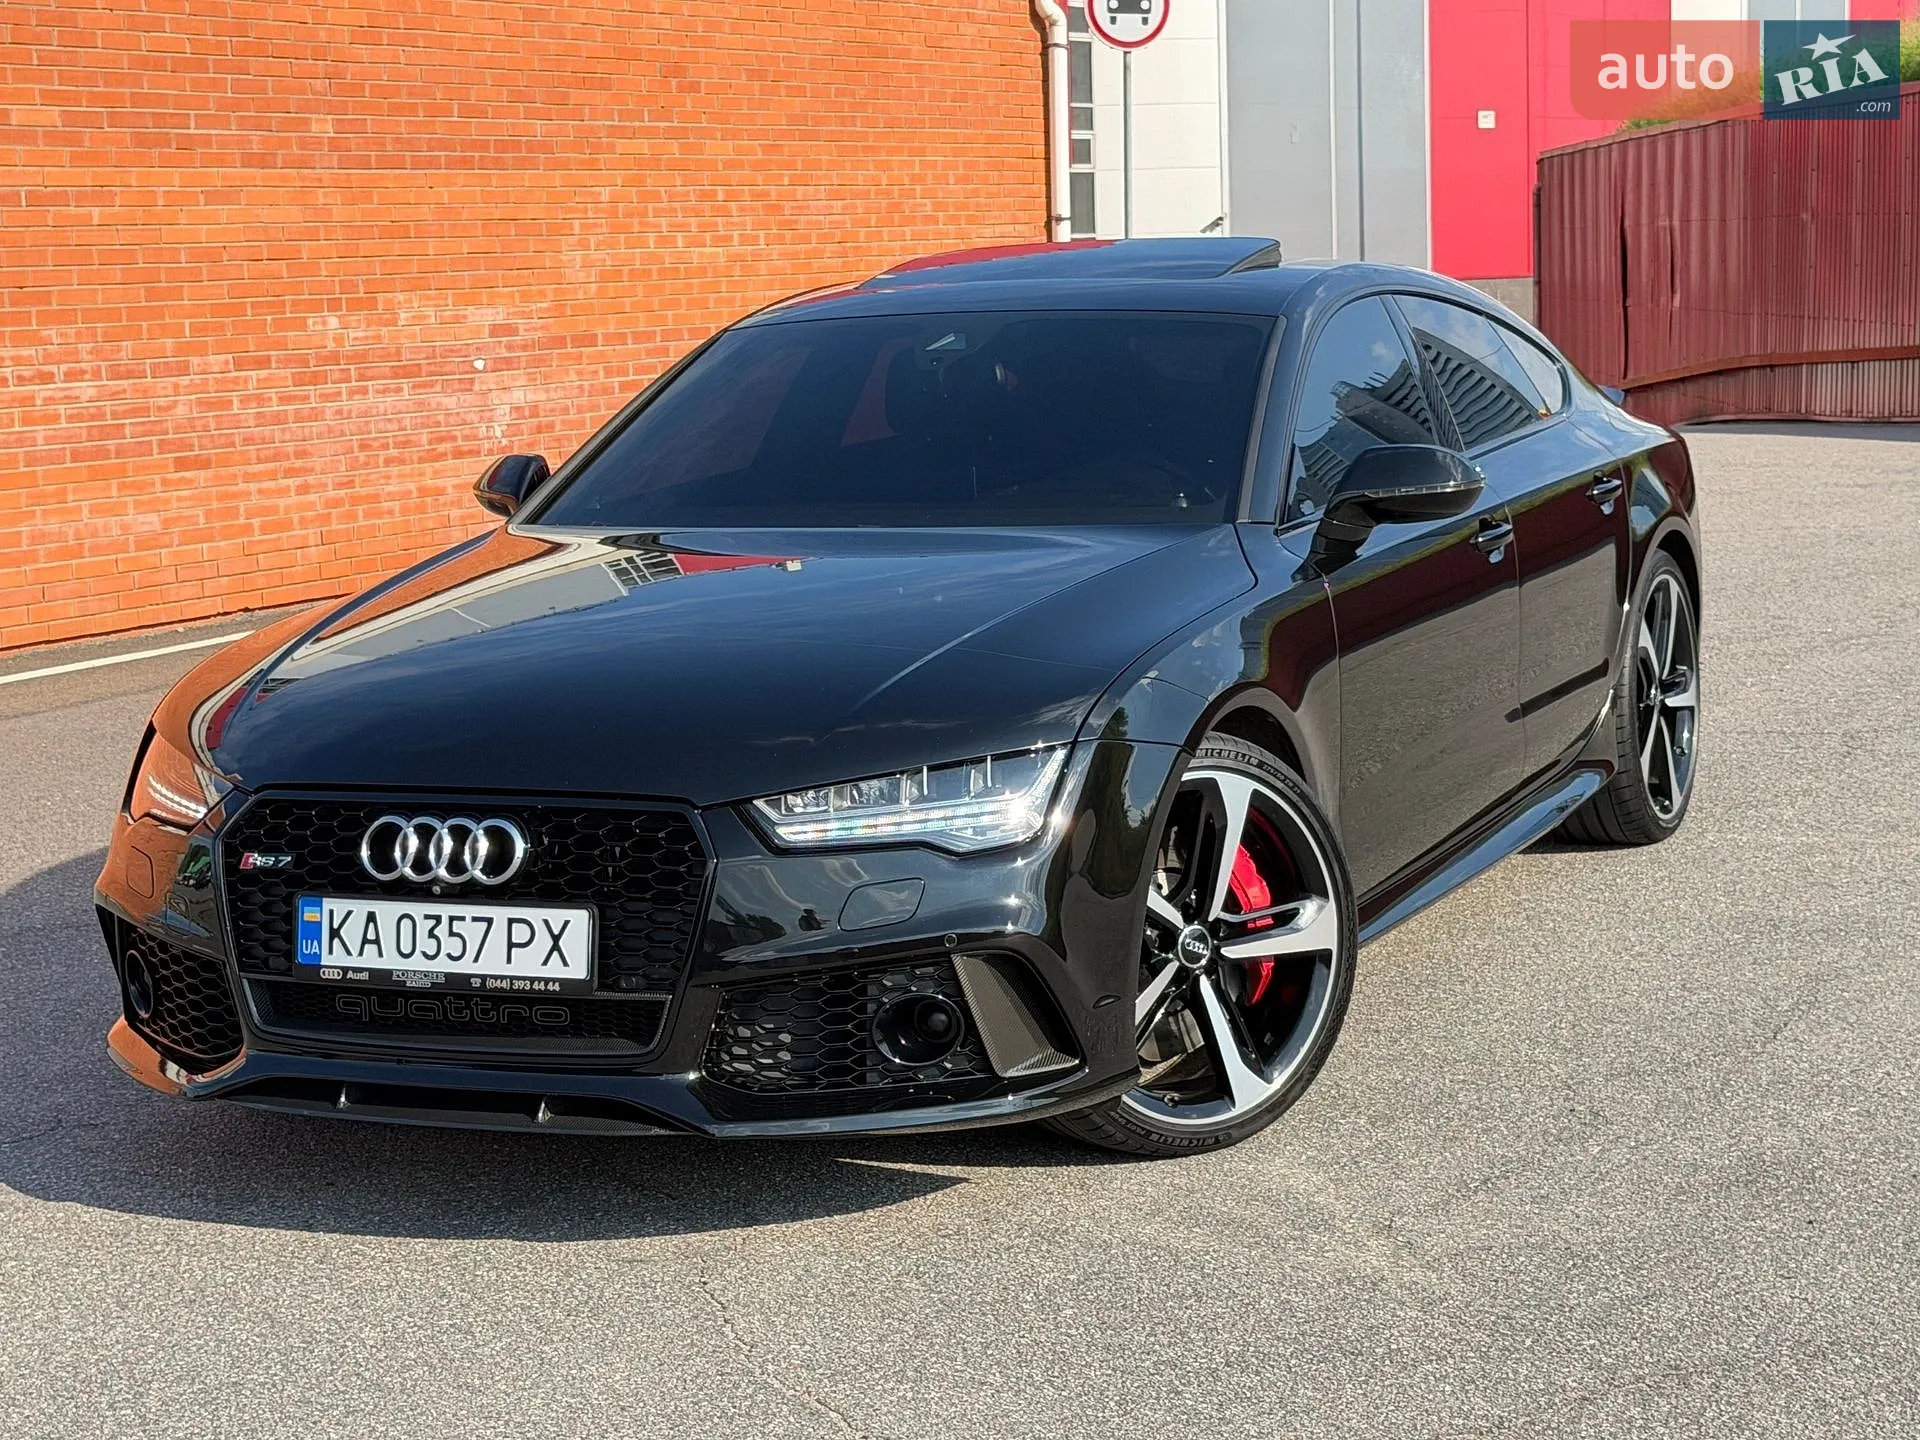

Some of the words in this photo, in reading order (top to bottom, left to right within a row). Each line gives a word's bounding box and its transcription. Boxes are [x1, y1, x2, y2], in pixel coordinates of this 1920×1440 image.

[1195, 748, 1259, 767] MICHELIN
[327, 908, 384, 959] KA
[395, 912, 495, 963] 0357
[506, 917, 572, 968] PX
[302, 939, 320, 955] UA
[346, 970, 369, 981] Audi
[392, 970, 445, 982] PORSCHE
[486, 978, 510, 990] (044)
[512, 980, 531, 990] 393
[532, 980, 545, 991] 44
[547, 981, 560, 992] 44
[336, 994, 570, 1025] quattro
